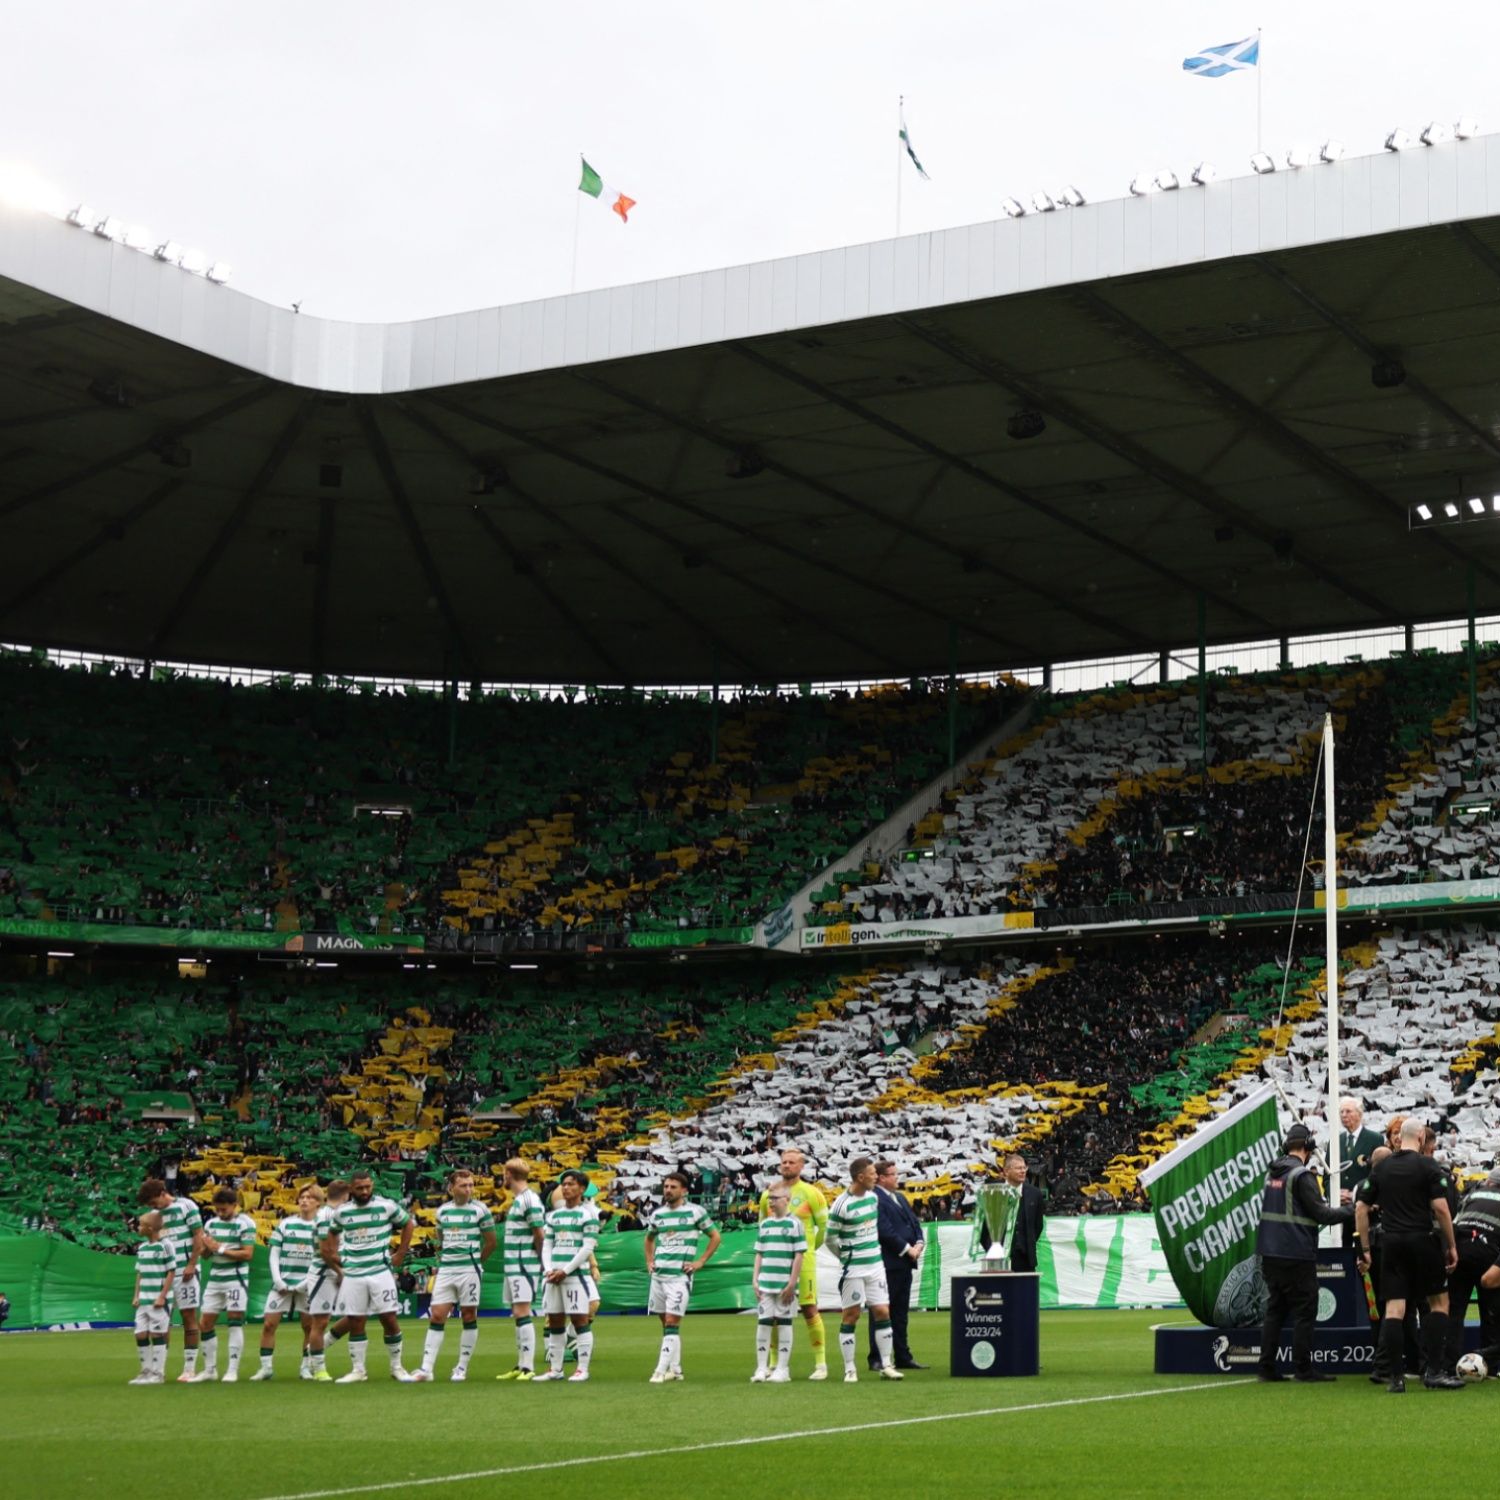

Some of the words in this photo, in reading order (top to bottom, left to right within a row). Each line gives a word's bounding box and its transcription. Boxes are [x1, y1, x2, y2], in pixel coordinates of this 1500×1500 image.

[1159, 1130, 1280, 1239] PREMIERSHIP
[1183, 1188, 1265, 1273] CHAMPIO
[469, 1283, 477, 1296] 2
[513, 1279, 520, 1292] 5
[181, 1287, 197, 1299] 33
[566, 1289, 578, 1303] 41
[674, 1291, 683, 1304] 3
[964, 1313, 1003, 1323] Winners
[964, 1327, 1002, 1337] 2023/24
[1275, 1345, 1339, 1363] Wiers
